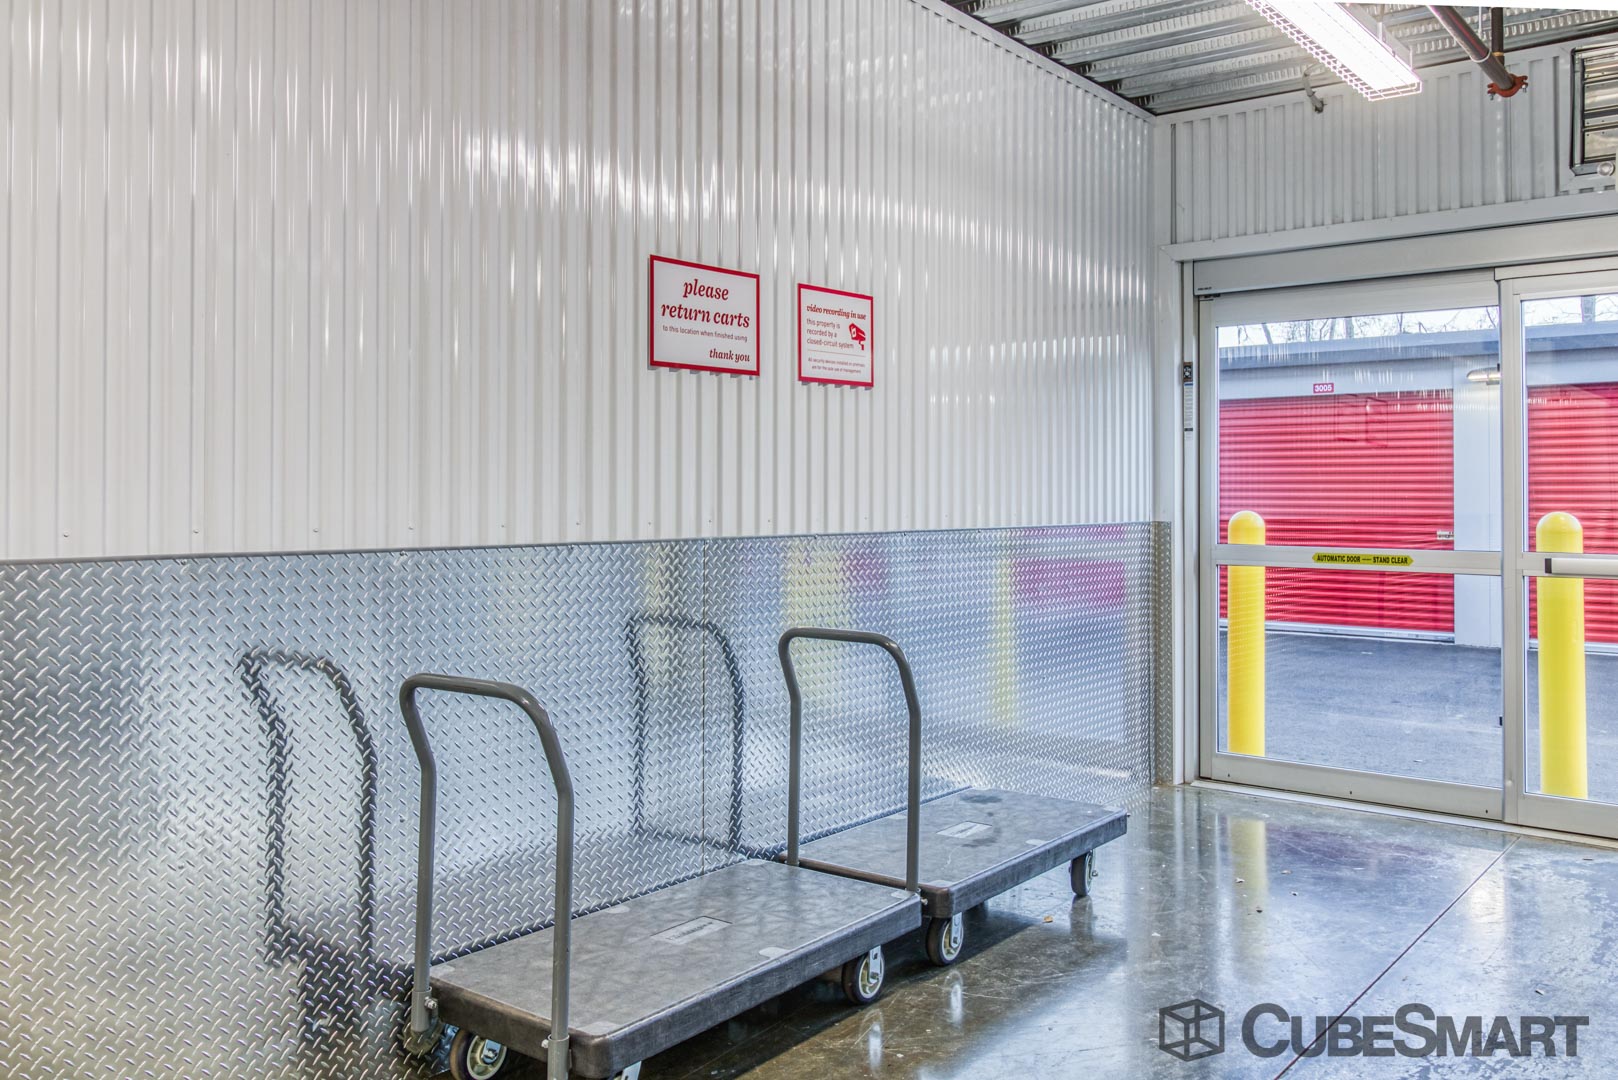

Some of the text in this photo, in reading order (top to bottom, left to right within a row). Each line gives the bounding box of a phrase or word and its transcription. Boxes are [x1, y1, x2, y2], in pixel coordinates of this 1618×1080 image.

[683, 279, 728, 300] please
[661, 304, 750, 328] return carts
[807, 304, 822, 314] video
[823, 309, 850, 319] recording
[680, 326, 699, 335] location
[817, 321, 835, 329] property
[807, 338, 854, 350] closed-circuit system
[710, 348, 750, 363] thank you
